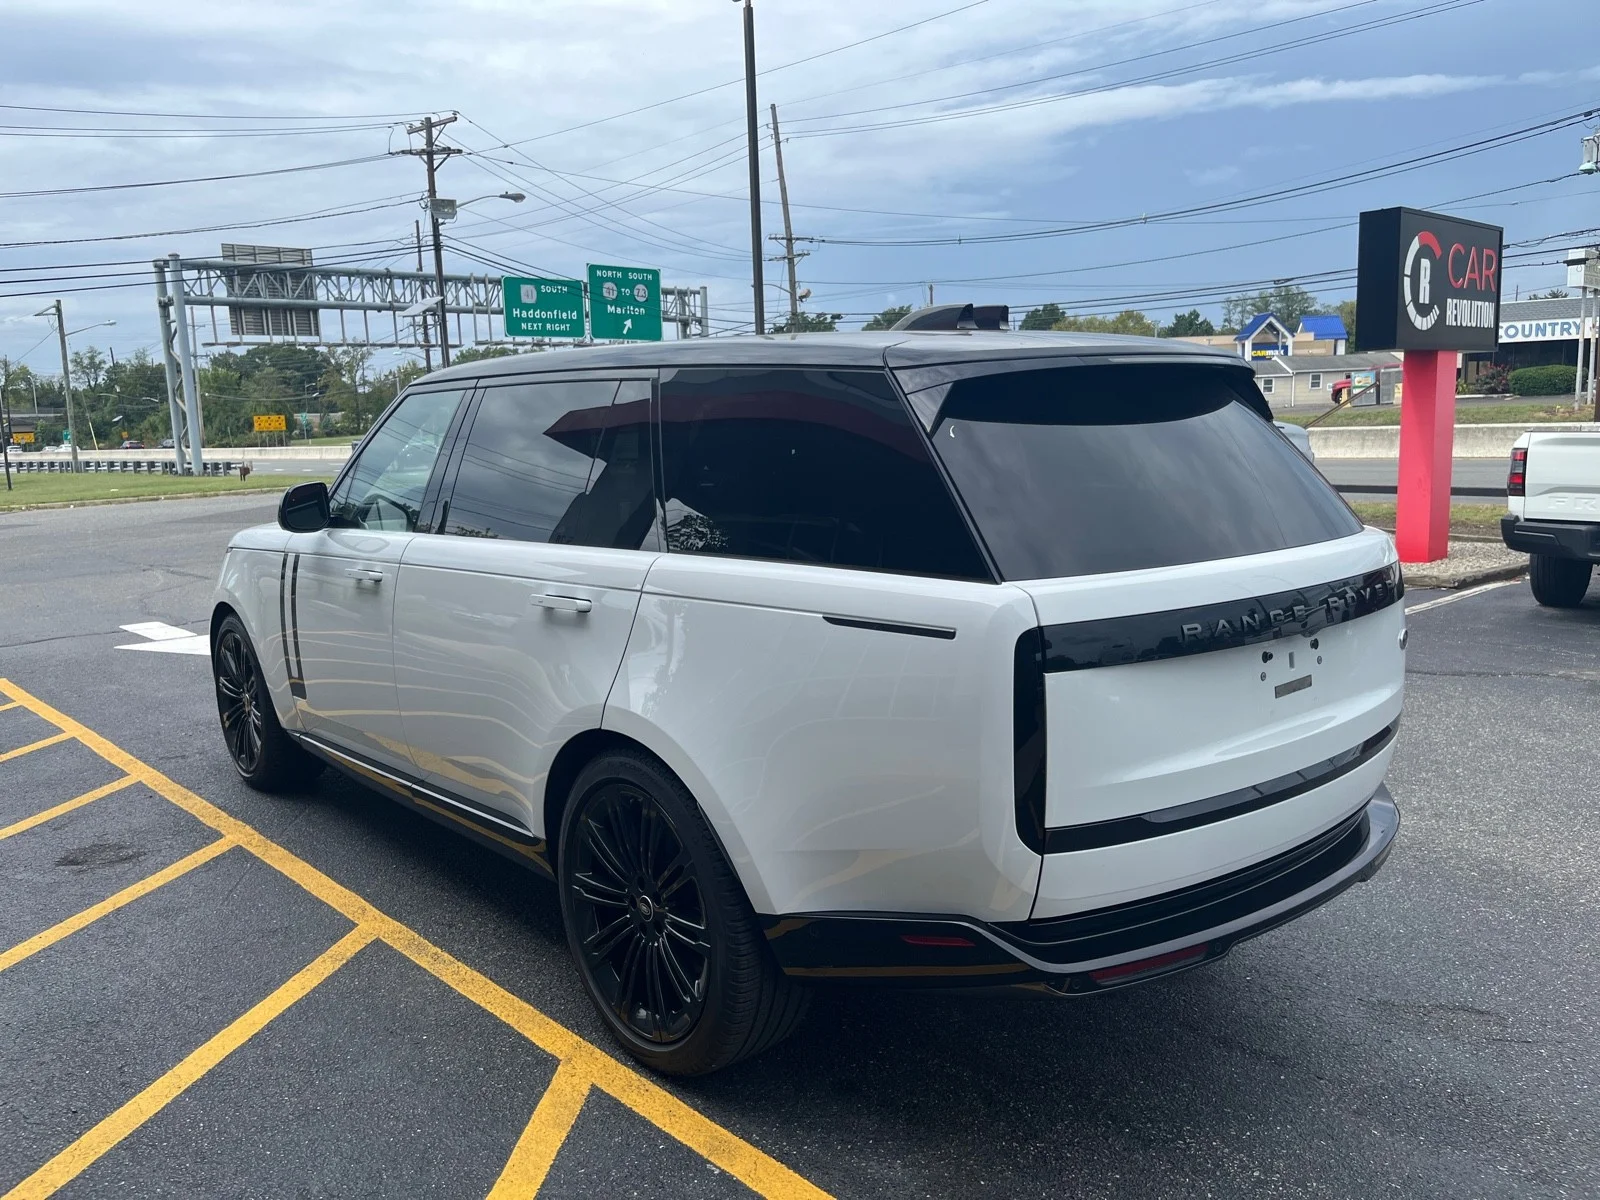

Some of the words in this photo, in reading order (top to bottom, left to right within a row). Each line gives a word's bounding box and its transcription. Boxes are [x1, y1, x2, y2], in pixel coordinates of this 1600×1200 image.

[1447, 242, 1497, 292] CAR
[596, 270, 622, 279] NORTH
[628, 272, 653, 281] SOUTH
[541, 285, 568, 294] SOUTH
[620, 288, 631, 296] TO
[512, 308, 578, 320] Haddonfield
[607, 304, 646, 315] Marlton
[1446, 298, 1495, 329] REVOLUTION
[521, 322, 543, 331] NEXT
[546, 323, 571, 332] RIGHT
[1499, 320, 1581, 339] OUNTRY
[1181, 605, 1308, 642] RANGE
